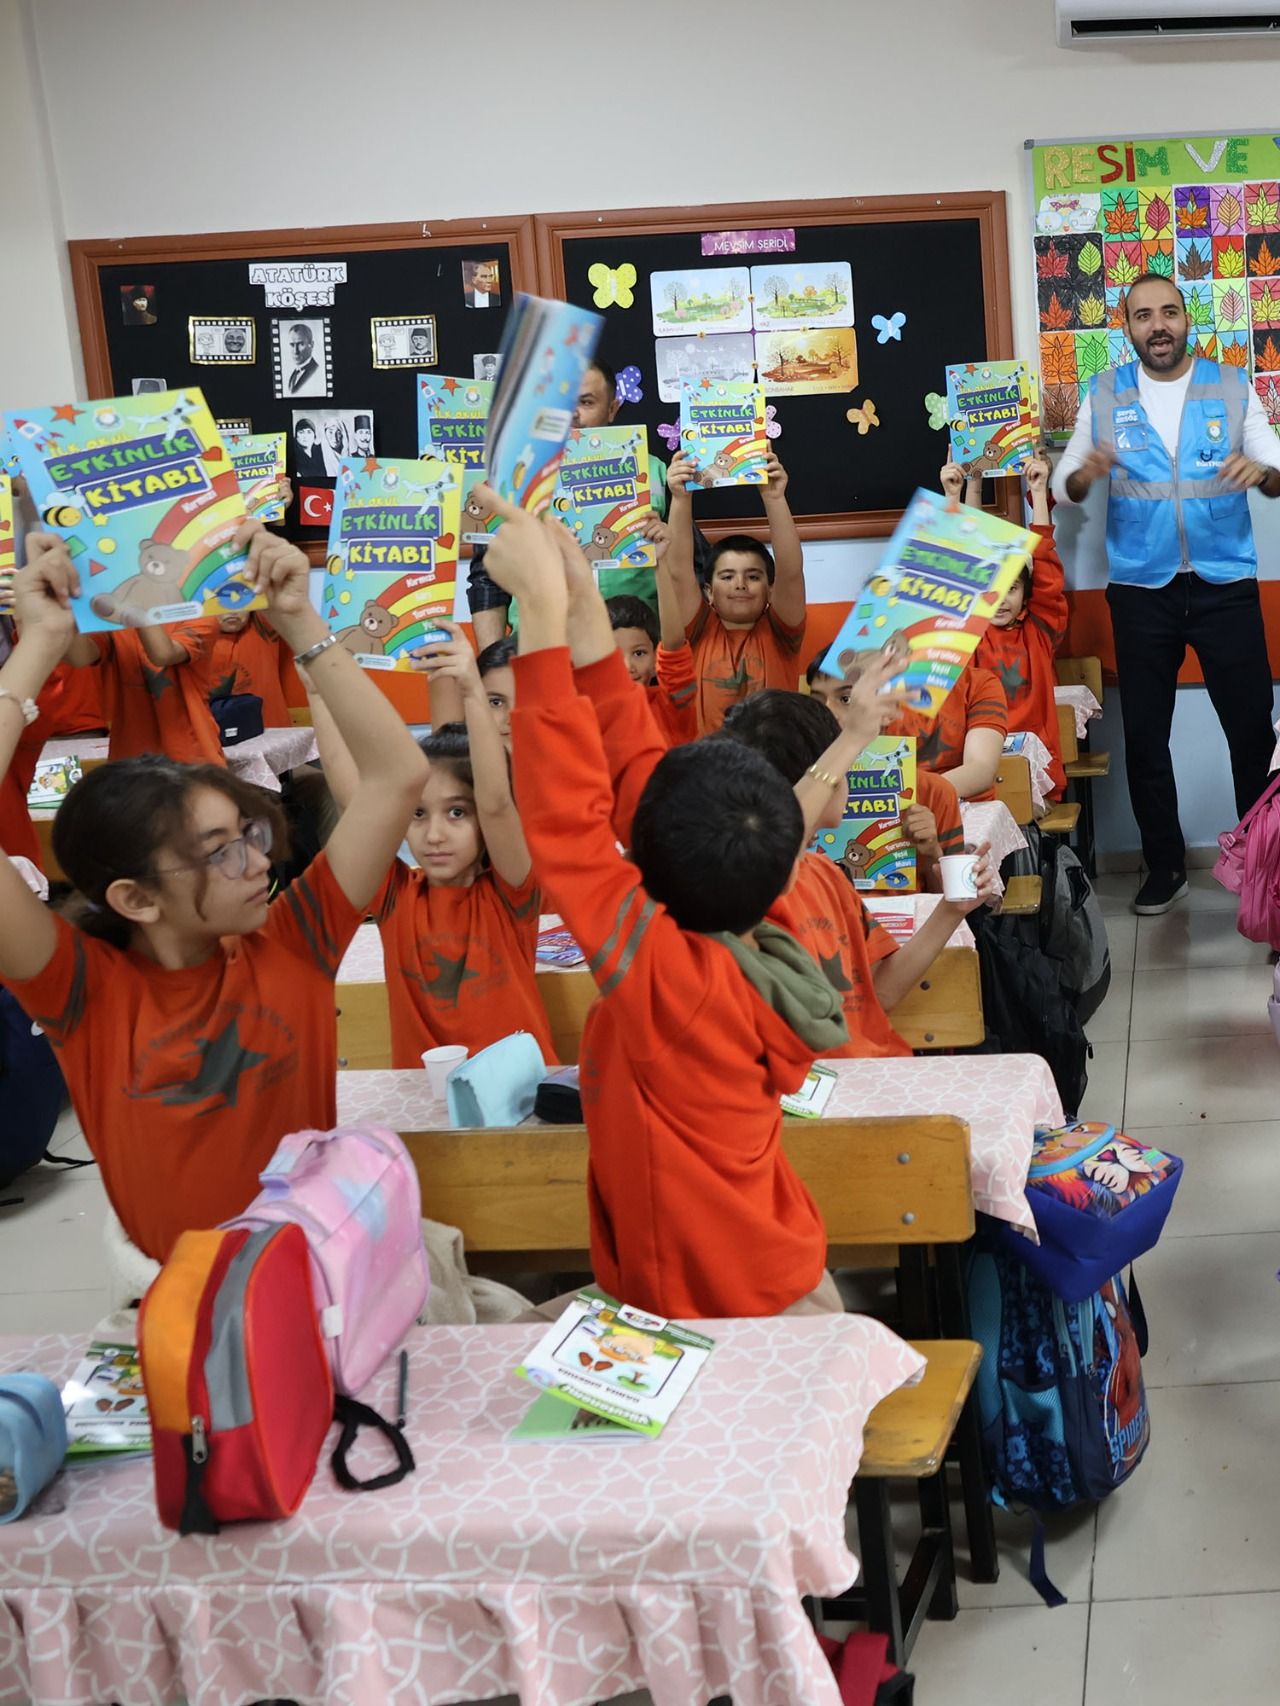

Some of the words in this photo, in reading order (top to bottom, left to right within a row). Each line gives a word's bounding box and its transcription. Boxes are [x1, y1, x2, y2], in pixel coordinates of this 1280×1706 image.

[1044, 141, 1171, 190] RESİM
[1184, 137, 1250, 174] VE
[714, 240, 755, 252] MEVSİM
[757, 238, 788, 250] ŞERİDİ
[252, 264, 345, 283] ATATÜRK
[267, 287, 335, 310] KÖŞESİ
[957, 389, 1018, 408] ETKİNLİK
[691, 408, 754, 419] ETKİNLİK
[969, 407, 1017, 423] KİTABI
[431, 422, 487, 438] ETKİN
[700, 423, 752, 435] KİTABI
[50, 435, 196, 482] ETKİNLİK
[446, 447, 485, 463] KİT
[237, 467, 273, 479] İTABI
[561, 461, 636, 482] ETKİNLİK
[85, 463, 204, 508] KİTABI
[574, 483, 633, 502] KİTABI
[341, 510, 438, 532] ETKİNLİK
[349, 541, 431, 564] KİTABI
[898, 574, 975, 613] KİTABI
[850, 774, 899, 789] İNLİK
[844, 799, 895, 814] TABI
